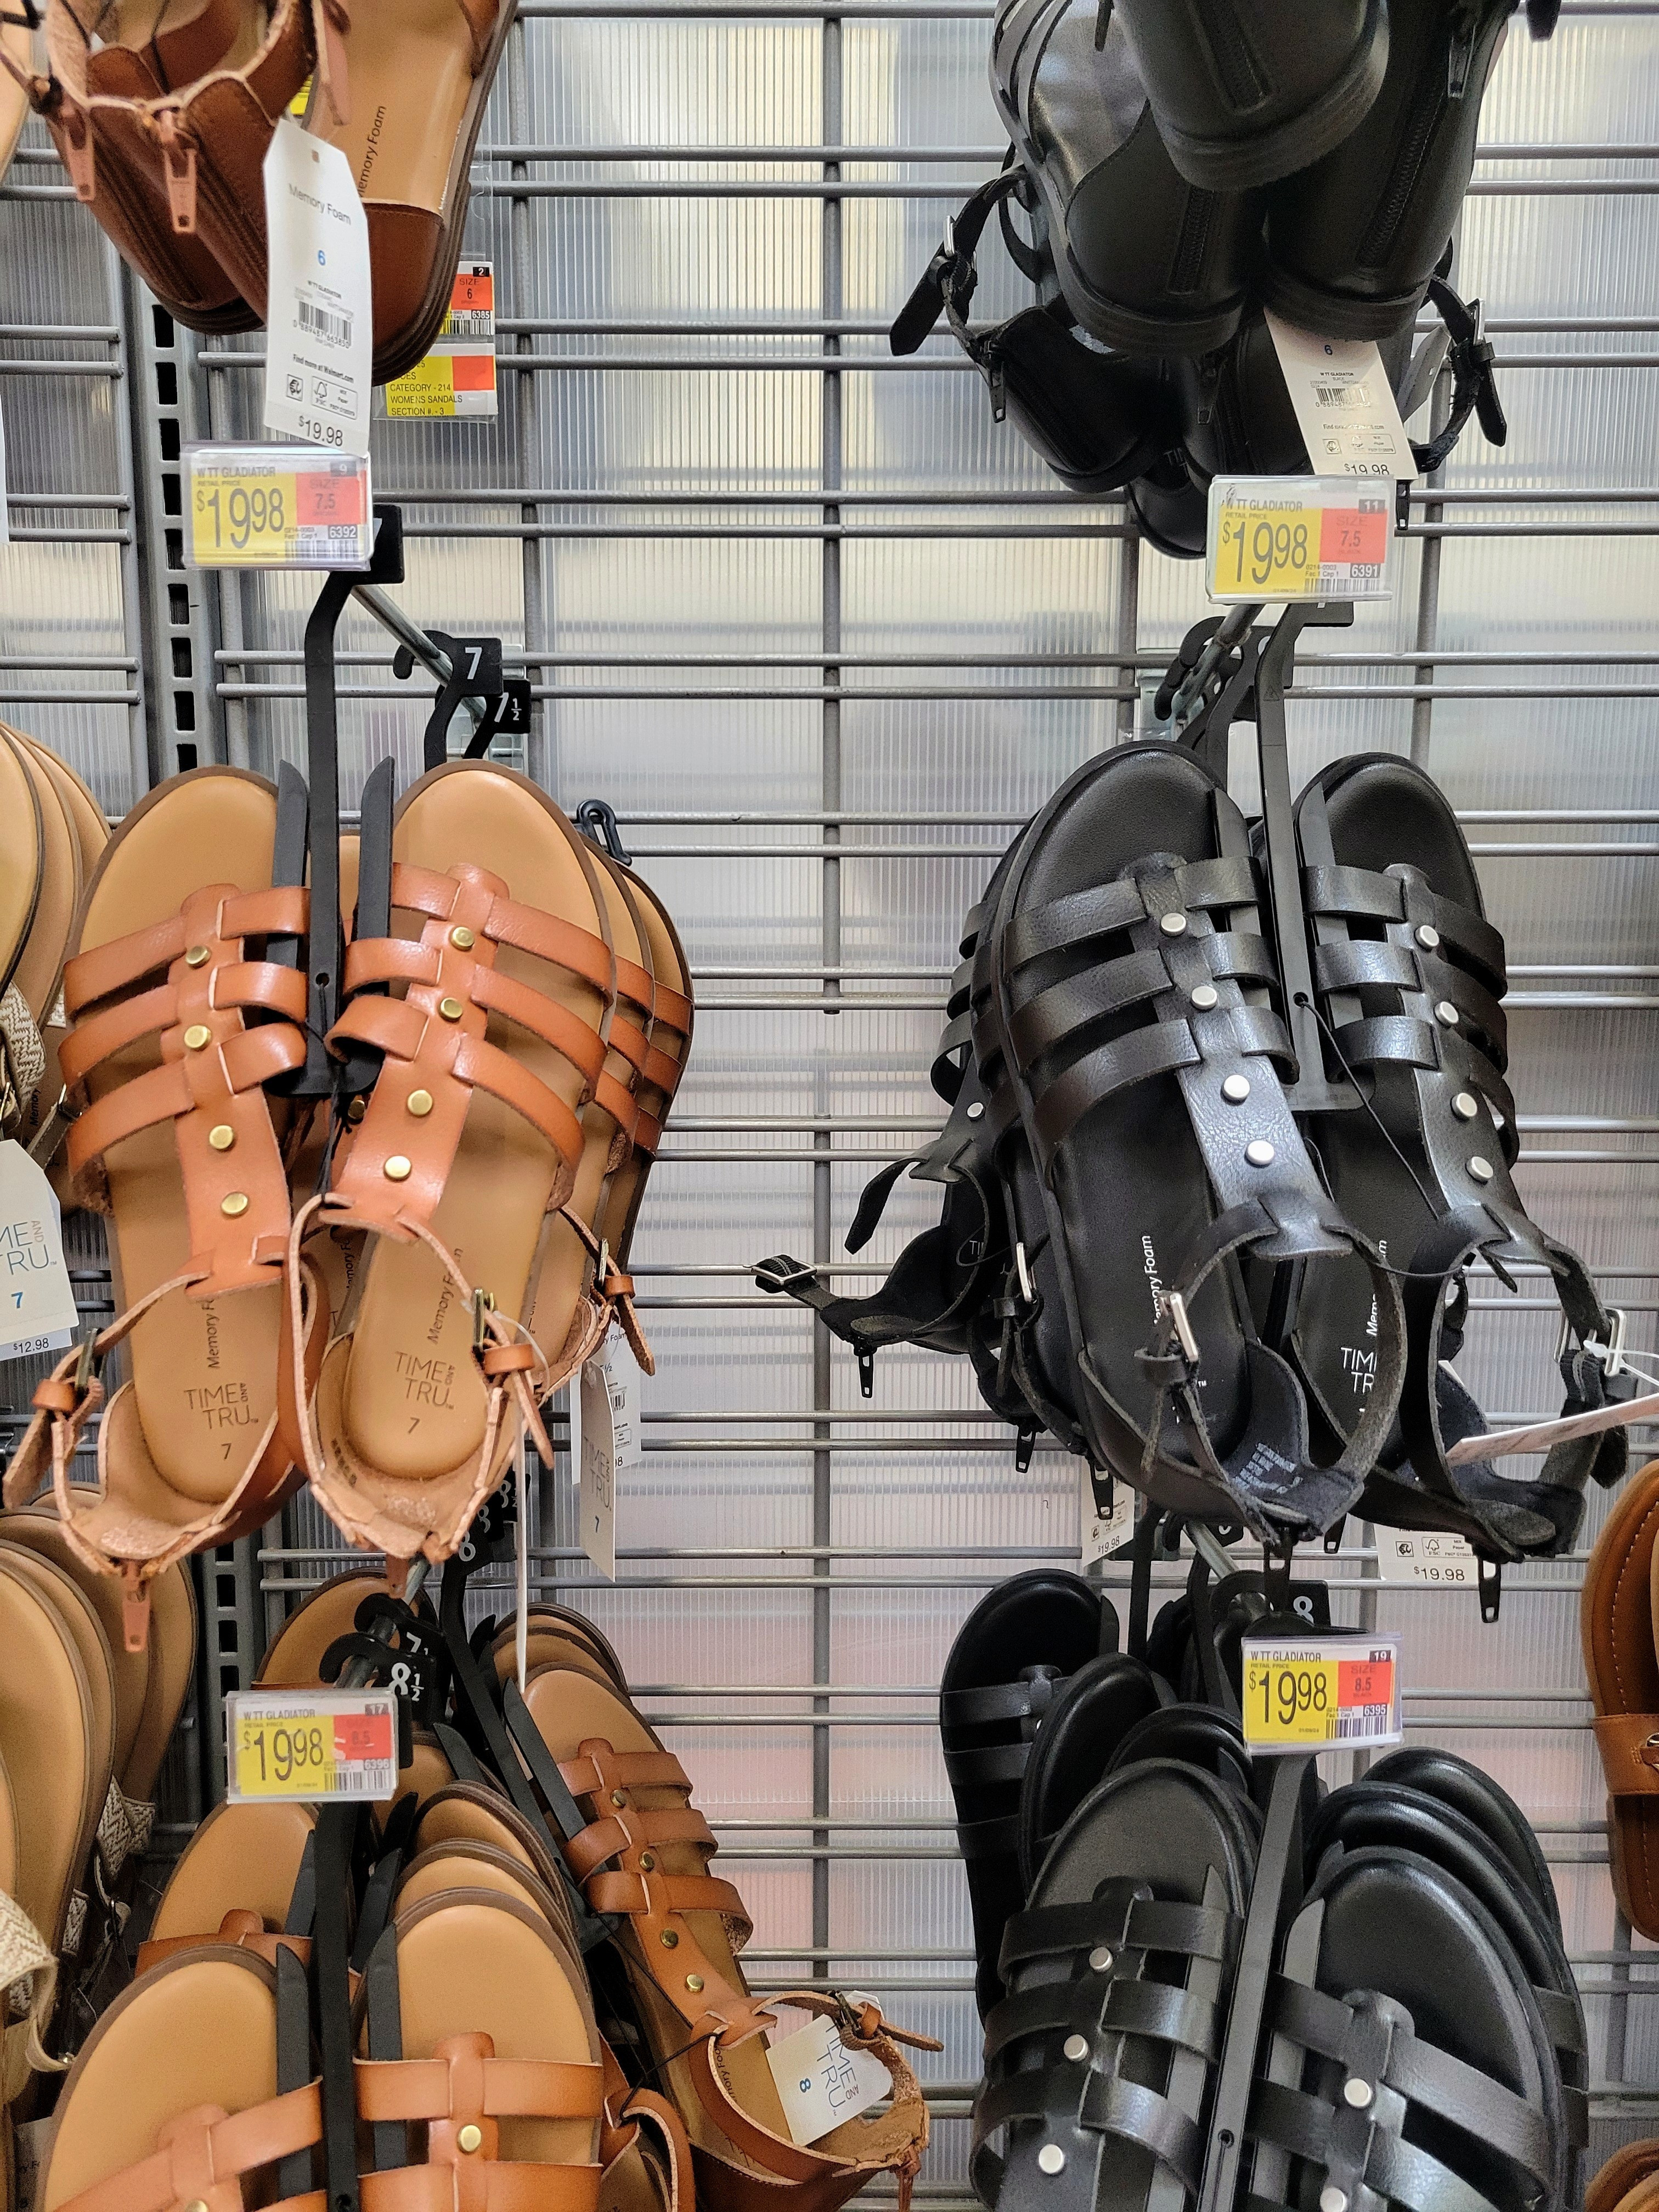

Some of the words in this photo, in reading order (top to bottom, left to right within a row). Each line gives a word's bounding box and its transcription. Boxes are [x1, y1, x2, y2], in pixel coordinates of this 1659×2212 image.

[367, 106, 387, 145] Foam
[289, 183, 325, 213] Memory
[328, 204, 351, 225] Foam
[318, 250, 326, 266] 6
[467, 289, 472, 299] 6
[472, 311, 490, 319] 6385
[1324, 345, 1333, 355] 6
[428, 395, 462, 403] SANDALS
[299, 415, 343, 447] $19.98
[197, 468, 206, 478] W
[207, 467, 219, 478] TT
[222, 467, 276, 478] GLADIATOR
[341, 465, 347, 475] 9
[1344, 464, 1390, 475] $1998
[315, 494, 335, 510] 7.5
[1226, 499, 1234, 509] W
[1236, 499, 1248, 510] TT
[1249, 500, 1302, 511] GLADIATOR
[1364, 501, 1379, 511] 11
[1336, 516, 1368, 527] SIZE
[329, 526, 356, 538] 6392
[1341, 531, 1361, 547] 7.5
[1351, 565, 1378, 577] 6391
[465, 647, 482, 680] 7
[29, 1088, 41, 1126] Memory
[31, 1220, 44, 1243] AND
[1142, 1235, 1158, 1274] Foam
[346, 1252, 356, 1289] mory
[12, 1292, 23, 1309] 7
[1149, 1272, 1163, 1325] emory
[427, 1288, 454, 1345] Memory
[207, 1314, 220, 1369] Memory
[611, 1332, 627, 1342] Foam
[14, 1338, 49, 1353] $12.98
[394, 1351, 447, 1383] TIME
[445, 1365, 455, 1386] AND
[1351, 1371, 1375, 1394] TR
[184, 1383, 240, 1409] TIME
[240, 1382, 249, 1402] AND
[408, 1417, 420, 1434] 7
[221, 1443, 232, 1460] 7
[584, 1436, 606, 1479] TIME
[595, 1515, 600, 1533] 7
[459, 1531, 476, 1562] 8
[1098, 1536, 1120, 1554] $19.98
[1414, 1566, 1465, 1581] $19.98
[1293, 1595, 1314, 1623] 8
[407, 1632, 421, 1653] 7
[1251, 1651, 1258, 1661] W
[1260, 1651, 1271, 1662] TT
[1273, 1651, 1321, 1663] GLADIATOR
[1374, 1651, 1387, 1661] 19
[1351, 1664, 1376, 1673] SIZE
[388, 1662, 411, 1695] 8
[1355, 1677, 1372, 1691] 8.5
[244, 1711, 251, 1720] W
[251, 1711, 263, 1720] TT
[266, 1709, 315, 1720] GLADIATOR
[371, 1705, 384, 1714] 17
[1364, 1704, 1386, 1716] 6395
[365, 1760, 390, 1770] 6396
[800, 2078, 811, 2093] 8
[845, 2084, 859, 2100] AND
